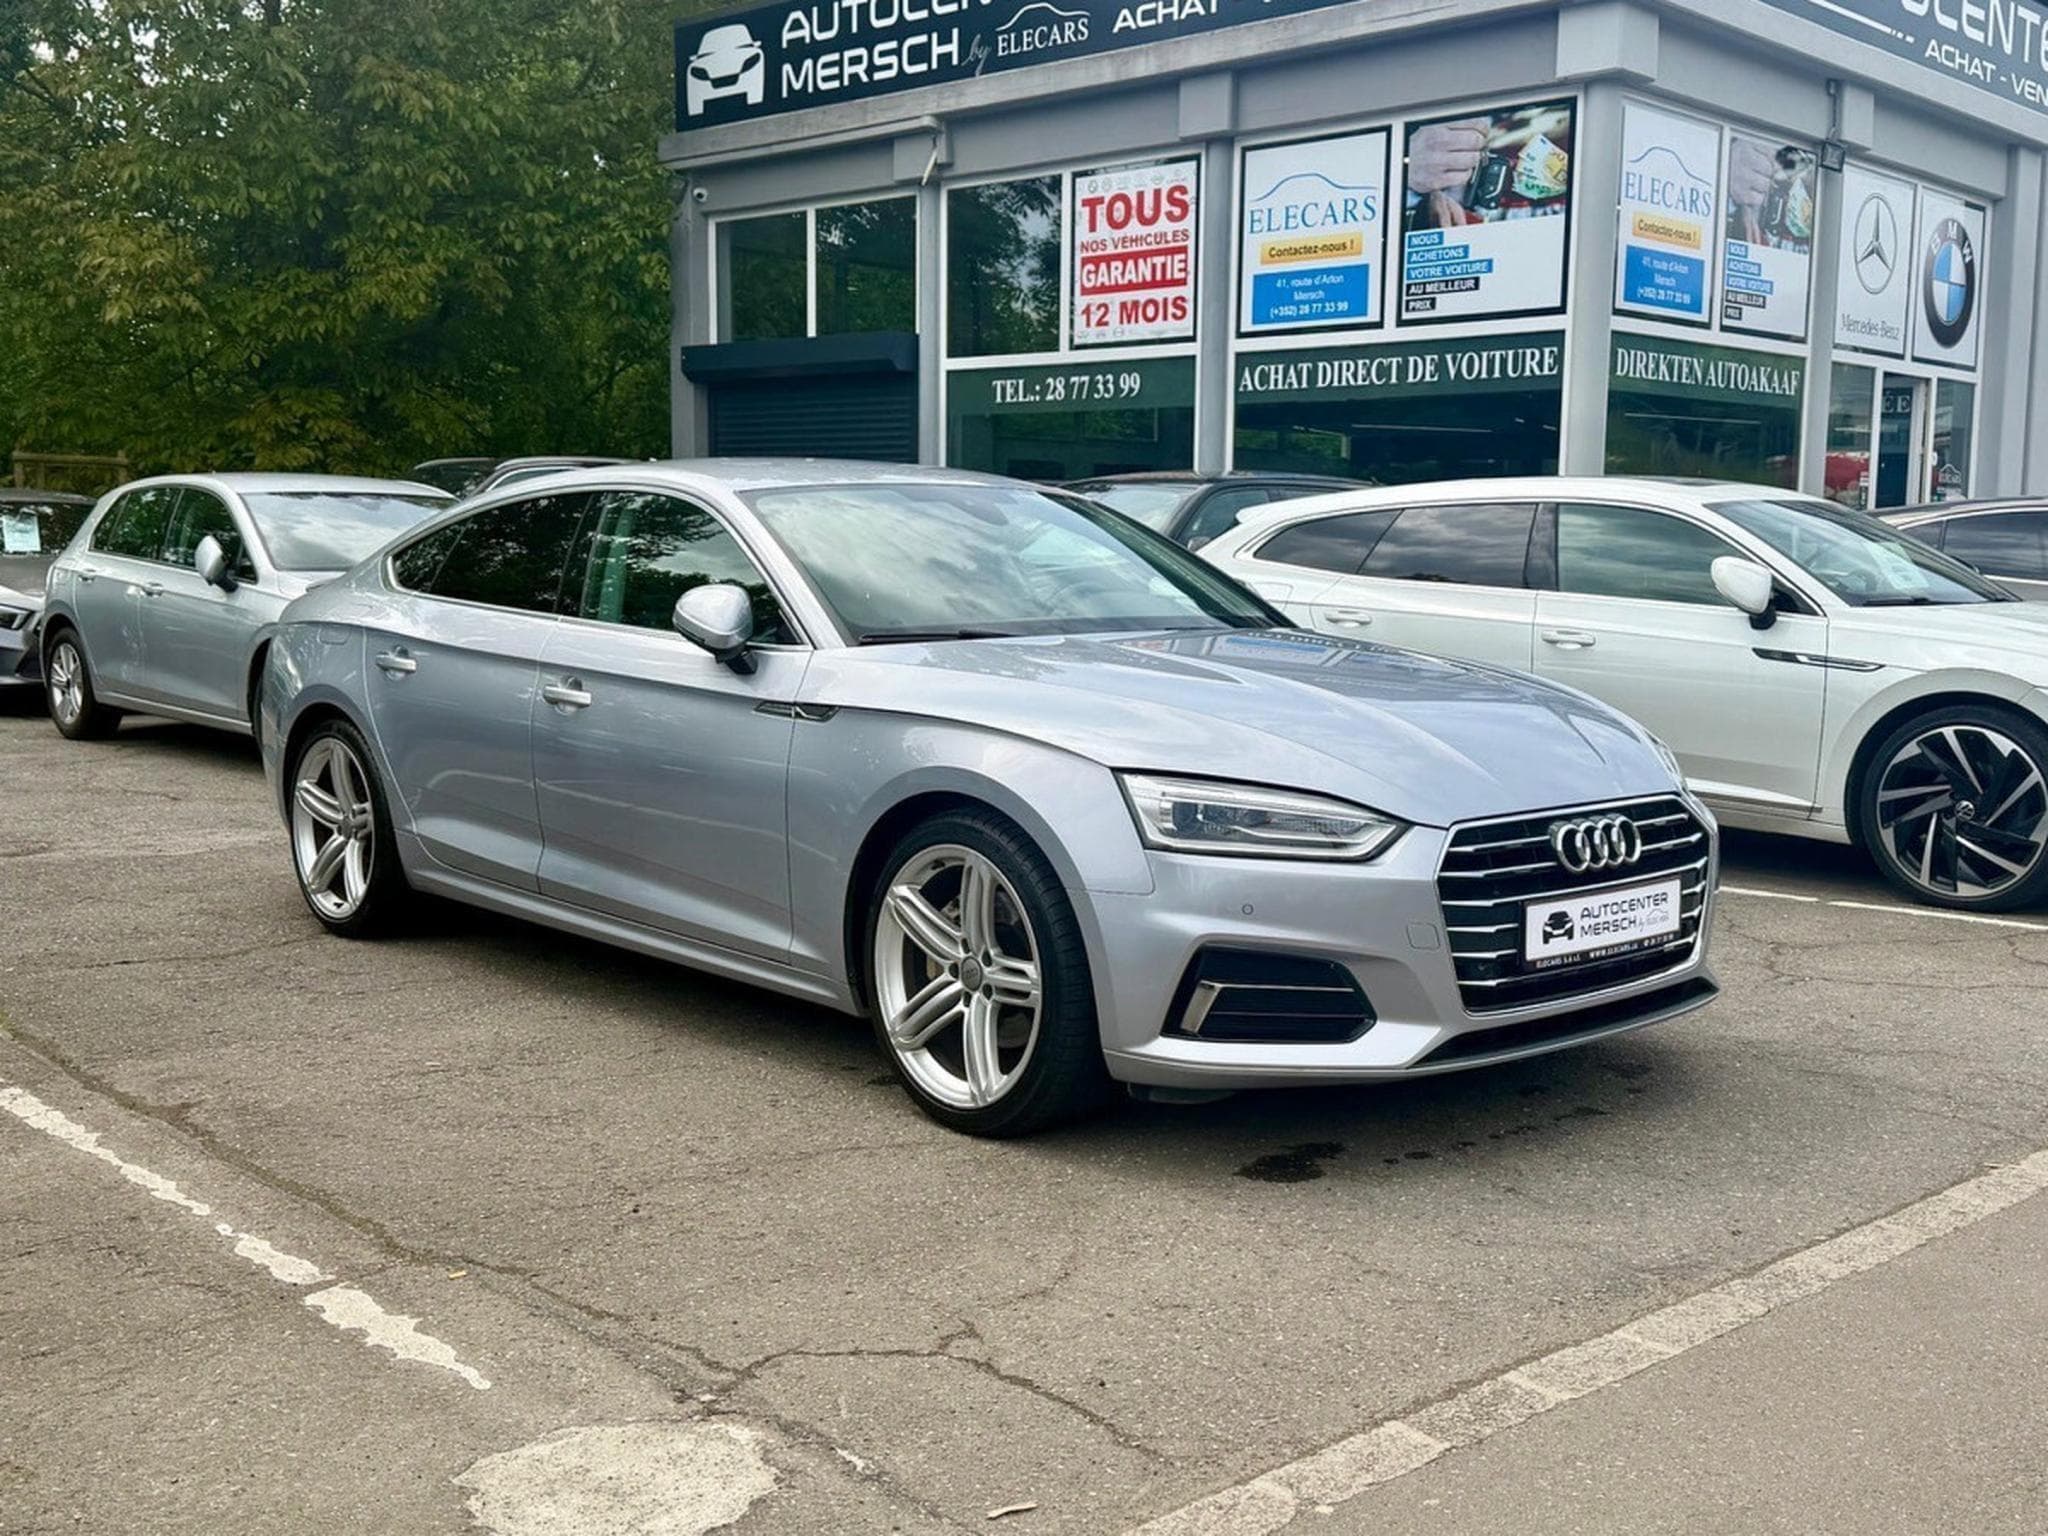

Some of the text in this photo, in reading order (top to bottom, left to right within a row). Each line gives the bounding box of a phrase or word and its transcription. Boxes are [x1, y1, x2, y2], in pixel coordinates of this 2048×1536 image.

[782, 18, 1090, 98] MERSCH by ELECARS
[1924, 38, 1996, 83] ACHAT
[1081, 185, 1190, 233] TOUS
[1625, 171, 1711, 217] ELECARS
[1249, 195, 1377, 234] ELECARS
[1080, 239, 1107, 253] NOS
[1269, 242, 1347, 258] Contactez-nous
[1411, 233, 1440, 245] NOUS
[1930, 220, 1973, 263] BMW
[1410, 248, 1464, 262] ACHETONS
[1410, 261, 1488, 279] VOTRE VOITURE
[1082, 254, 1186, 288] GARANTIE
[1409, 279, 1476, 295] AU MEILLEUR
[1081, 296, 1187, 328] 12 MOIS
[1312, 303, 1322, 313] 77
[1409, 300, 1431, 311] PRIX
[1841, 313, 1900, 341] Mercedes-Benz
[1238, 346, 1559, 392] ACHAT DIRECT DE VOITURE
[1616, 348, 1800, 396] DIREKTEN AUTOAKAAF
[992, 372, 1141, 404] TEL.: 28 77 33 99
[1580, 892, 1668, 920] AUTOCENTER
[1580, 916, 1637, 938] MERSCH
